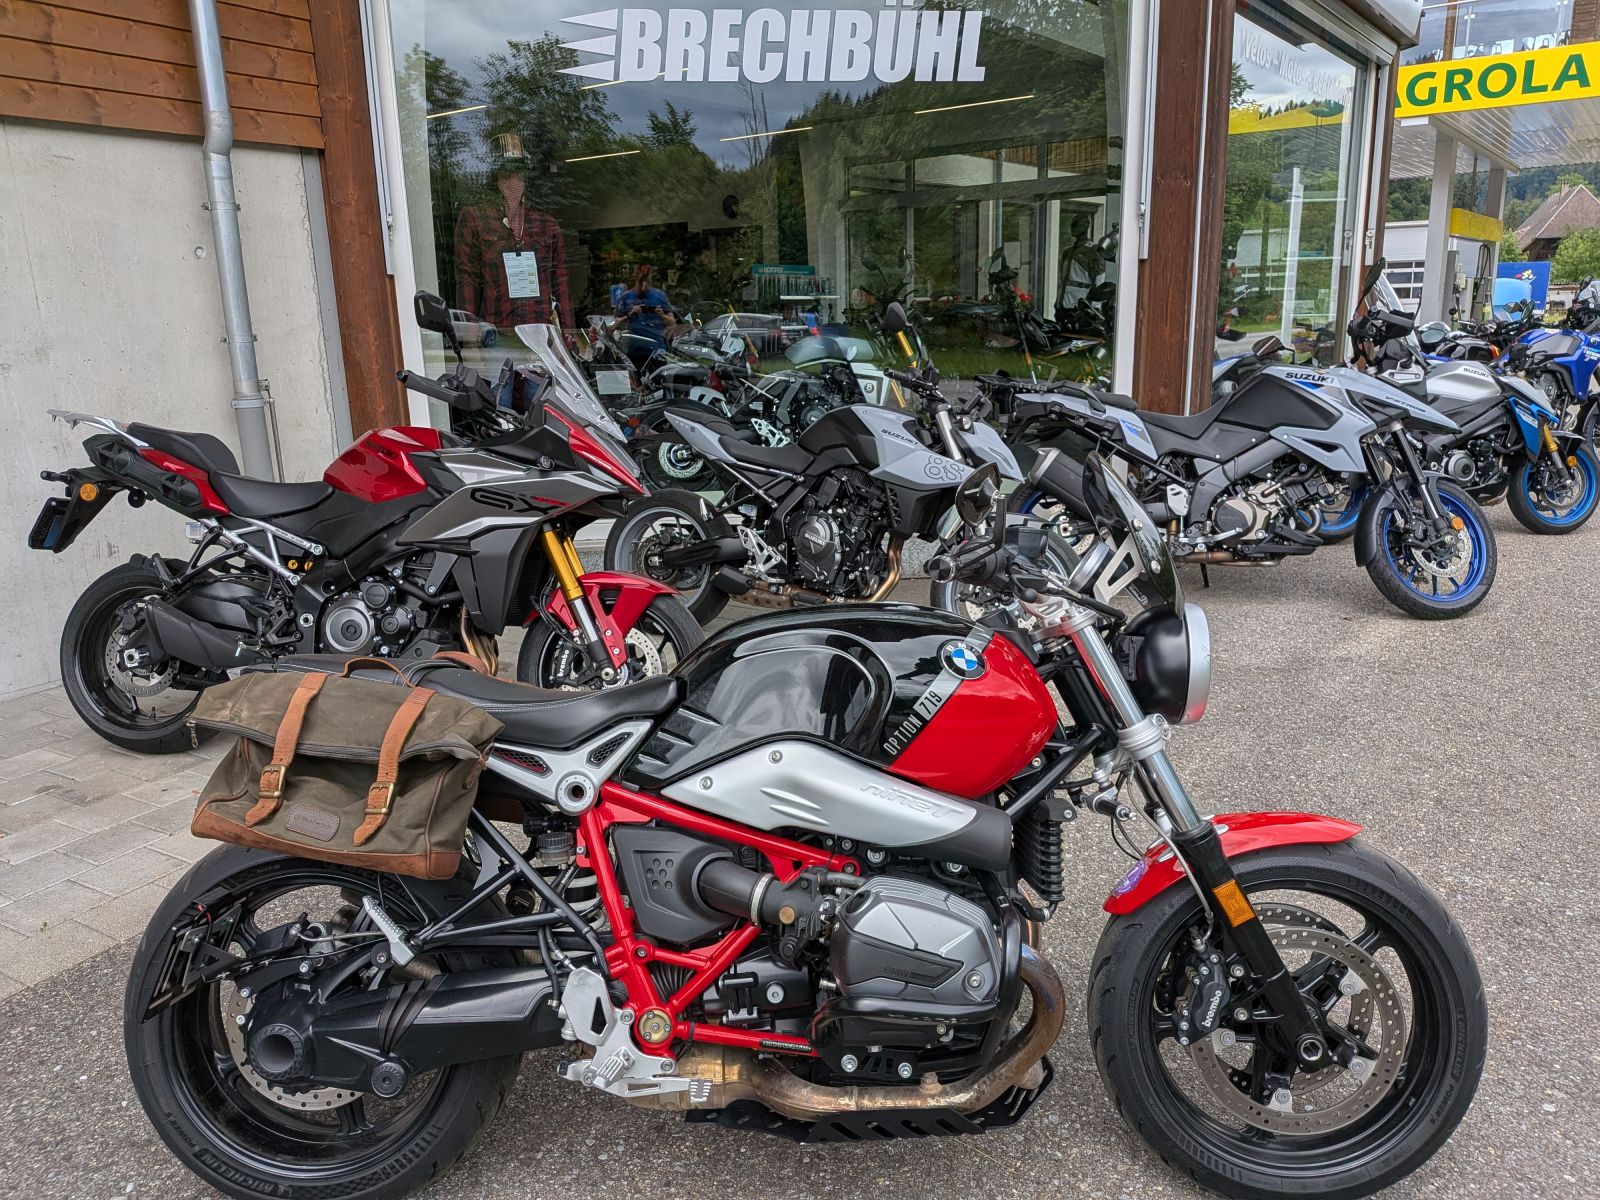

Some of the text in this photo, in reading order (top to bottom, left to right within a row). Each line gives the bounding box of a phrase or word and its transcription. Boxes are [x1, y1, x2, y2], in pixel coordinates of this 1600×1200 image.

[618, 0, 987, 84] BRECHBÜHL
[1284, 371, 1335, 385] SUZUKI
[1463, 366, 1490, 379] SUZUKI
[881, 428, 919, 446] SUZUKI
[556, 649, 570, 677] brembo
[918, 690, 943, 716] 719
[883, 713, 923, 756] OPTION
[1201, 990, 1222, 1028] brembo
[200, 1151, 276, 1195] MICHELIN
